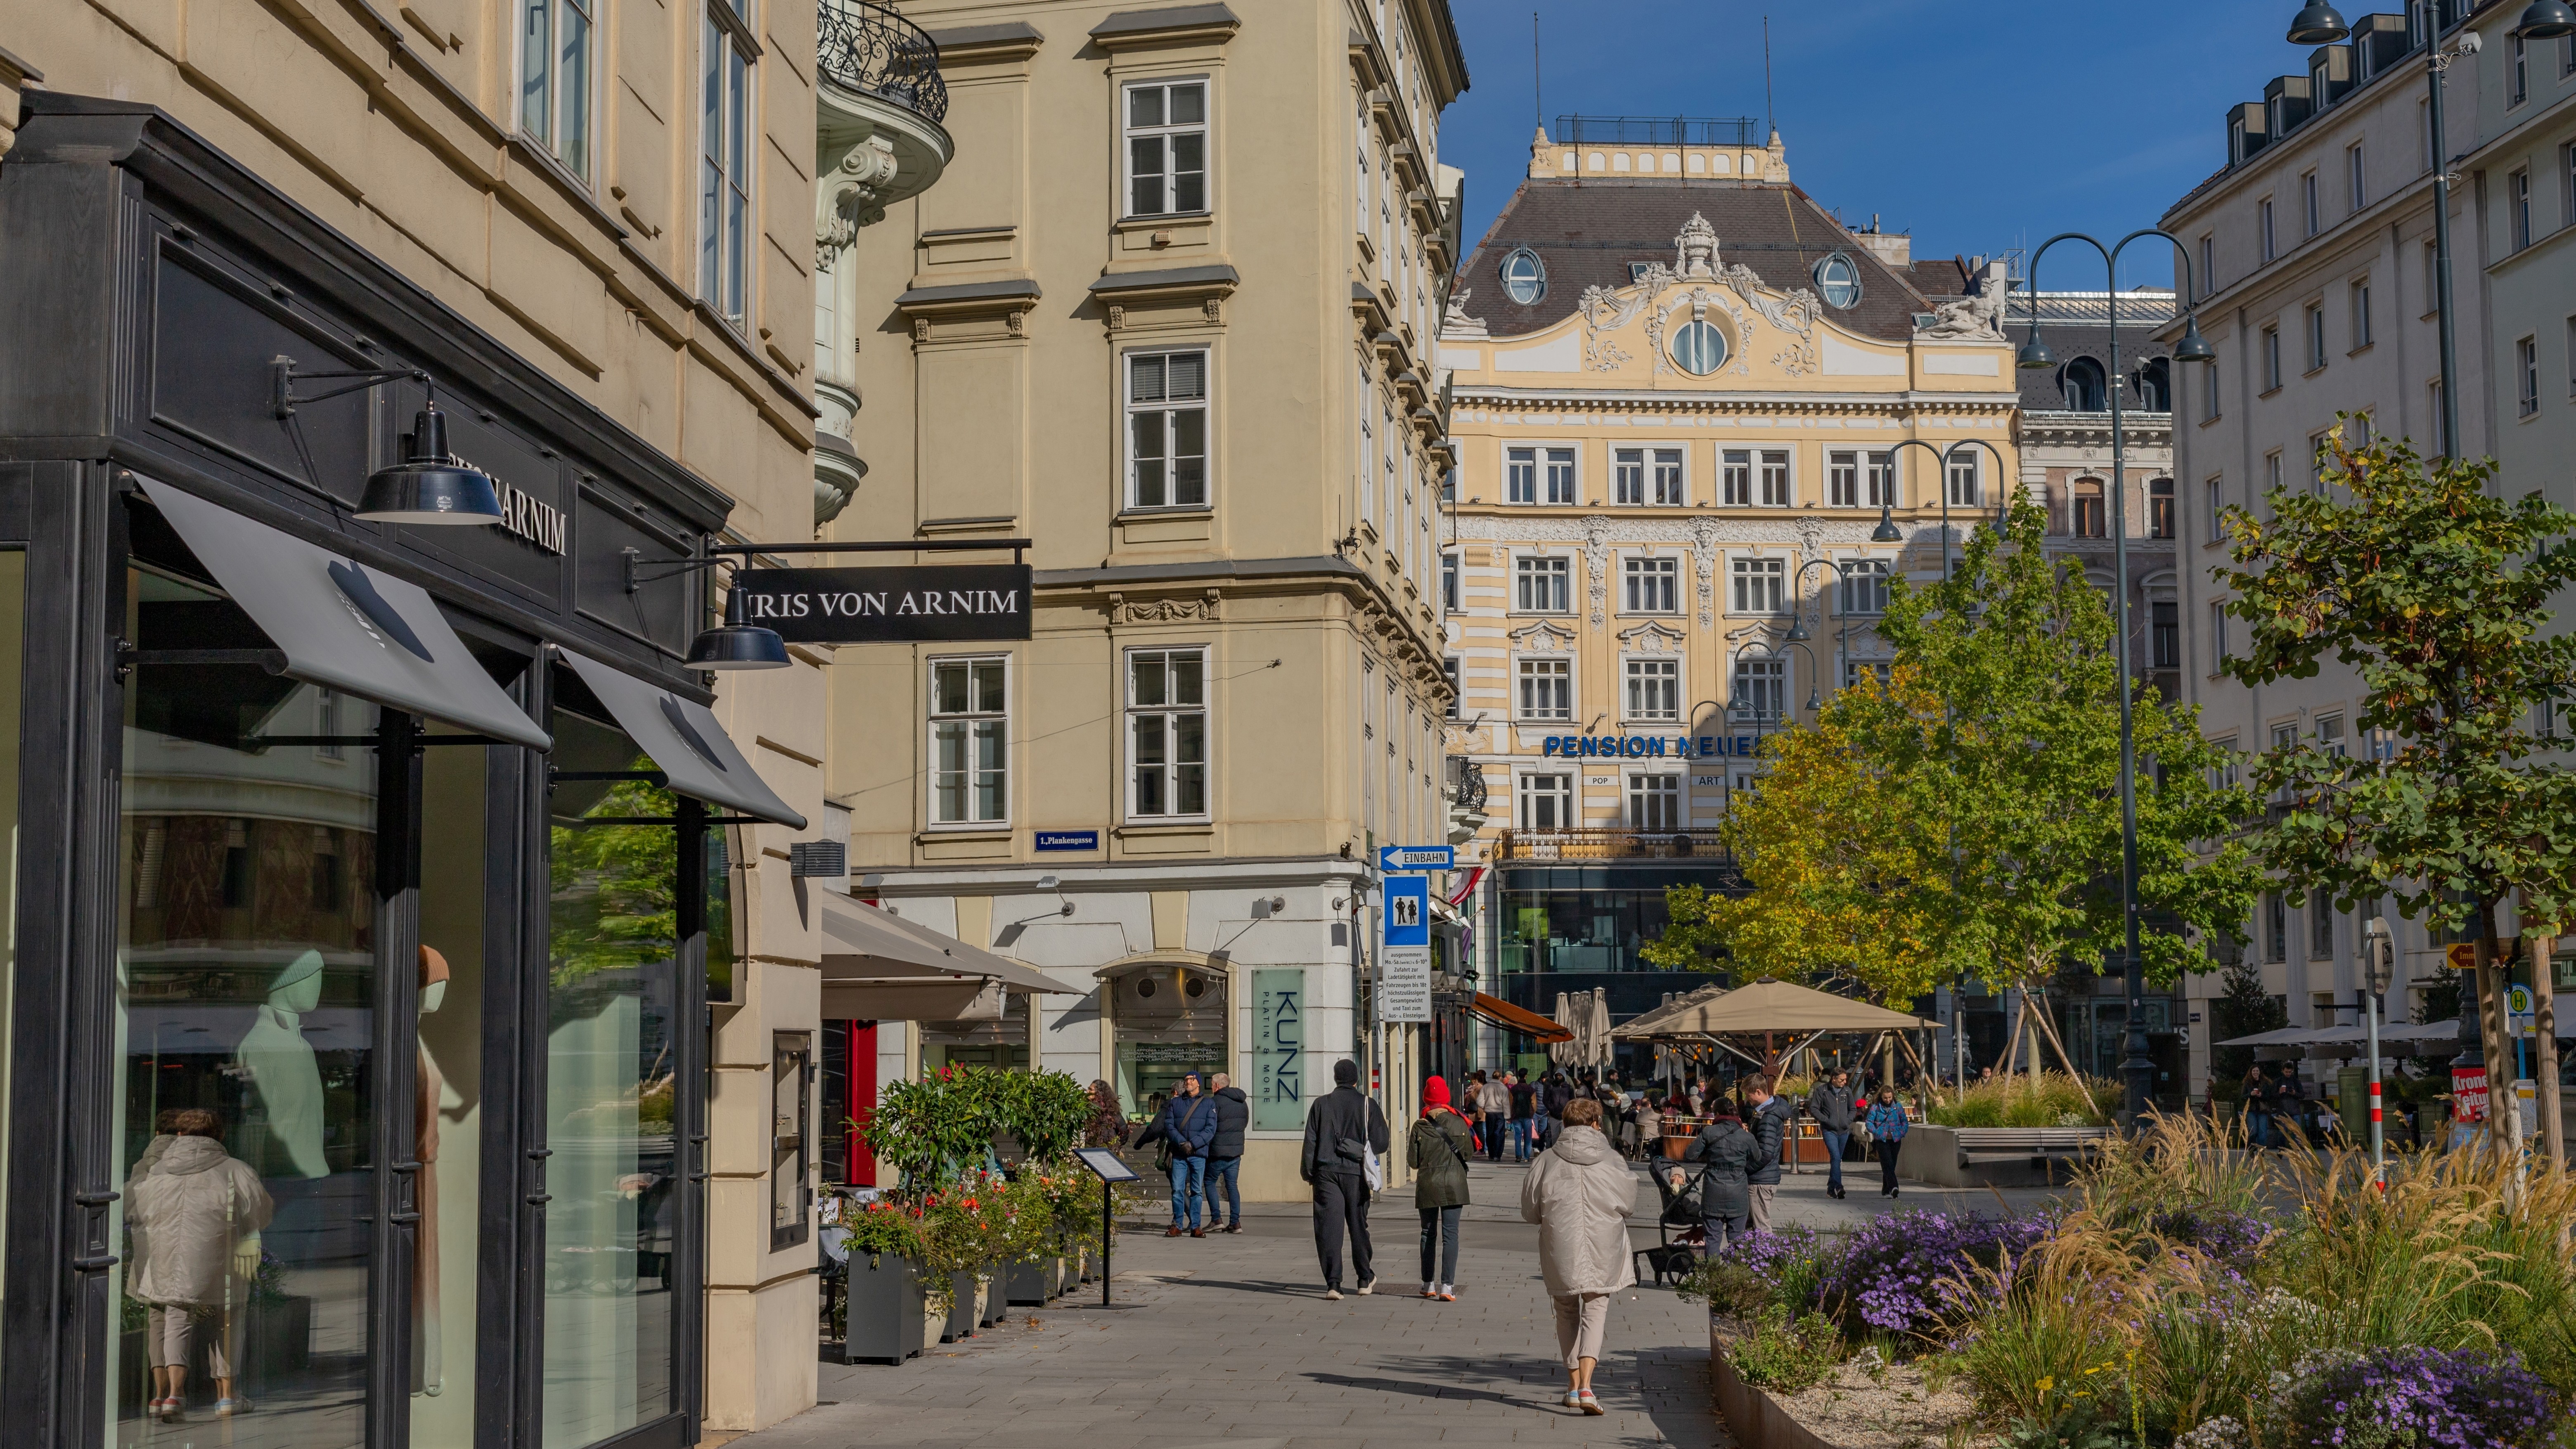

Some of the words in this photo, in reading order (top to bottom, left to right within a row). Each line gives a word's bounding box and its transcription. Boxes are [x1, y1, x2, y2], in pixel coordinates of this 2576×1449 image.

[498, 483, 566, 556] ARNIM
[818, 592, 888, 616] VON
[896, 590, 1018, 614] ARNIM
[1546, 736, 1665, 756] PENSION
[1679, 736, 1759, 755] NEUE
[1699, 776, 1720, 785] ART
[1404, 852, 1445, 863] EINBAHN
[2514, 994, 2523, 1008] H
[1276, 992, 1298, 1103] KUNZ
